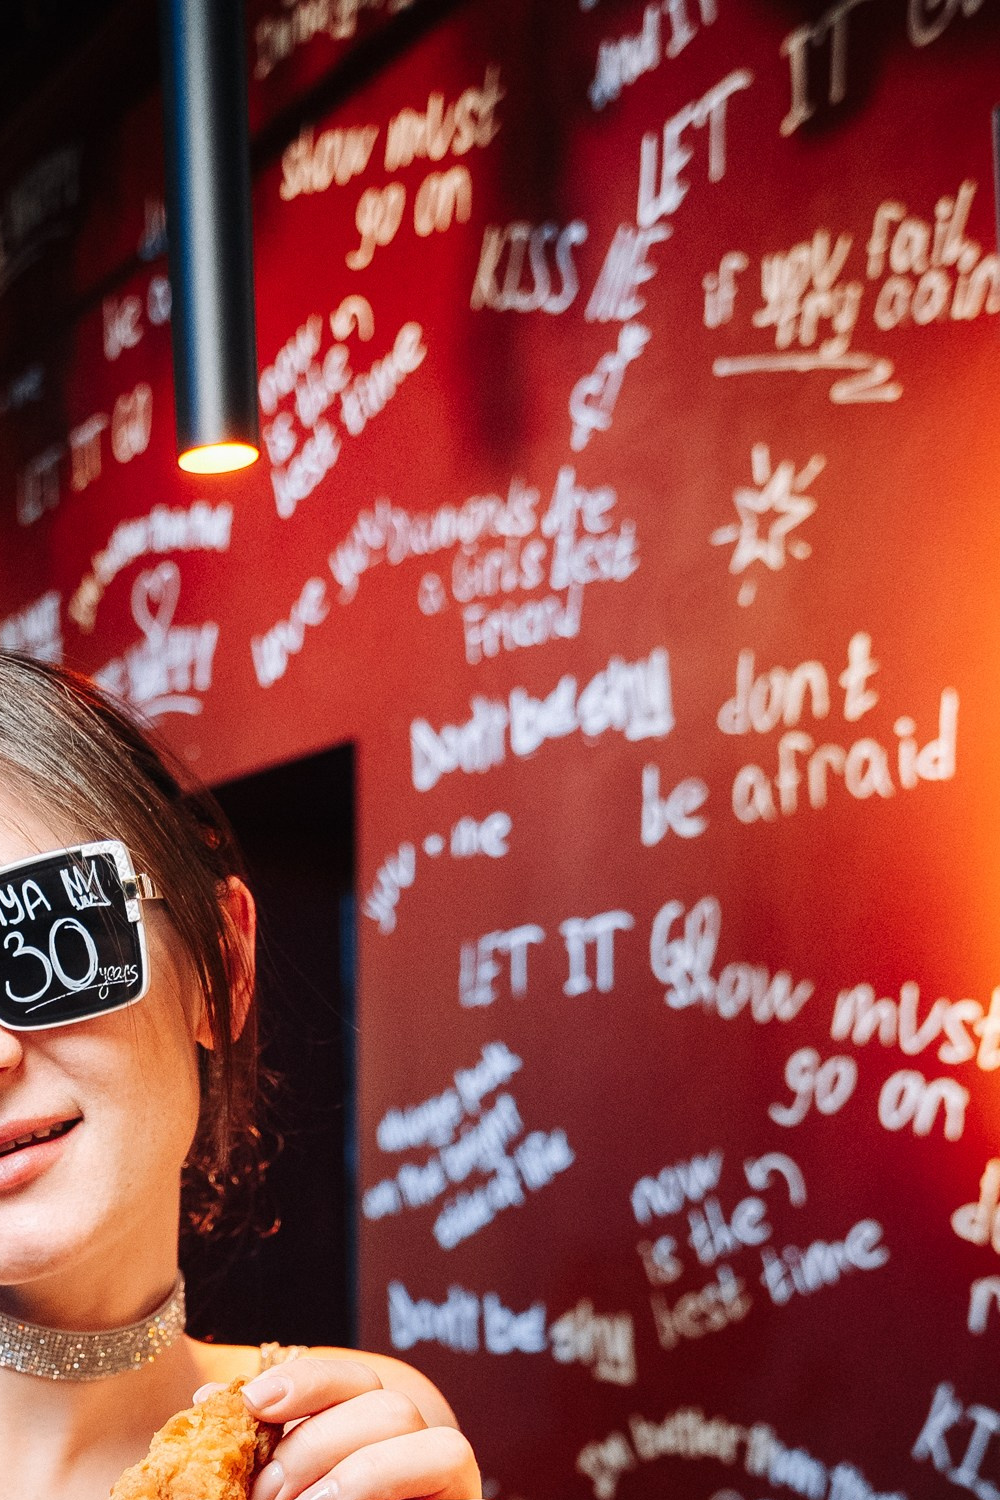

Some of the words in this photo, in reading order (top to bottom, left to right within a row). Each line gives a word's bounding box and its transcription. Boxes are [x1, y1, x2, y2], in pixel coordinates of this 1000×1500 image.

[636, 68, 755, 229] LET
[345, 181, 407, 271] go
[414, 164, 473, 238] on
[469, 220, 589, 315] KISS
[640, 761, 711, 848] be
[731, 685, 961, 826] afraid
[2, 917, 99, 1003] 30
[98, 963, 139, 1000] years
[457, 922, 547, 1009] LET
[558, 909, 636, 997] IT
[767, 1046, 860, 1128] go
[877, 1068, 971, 1143] on
